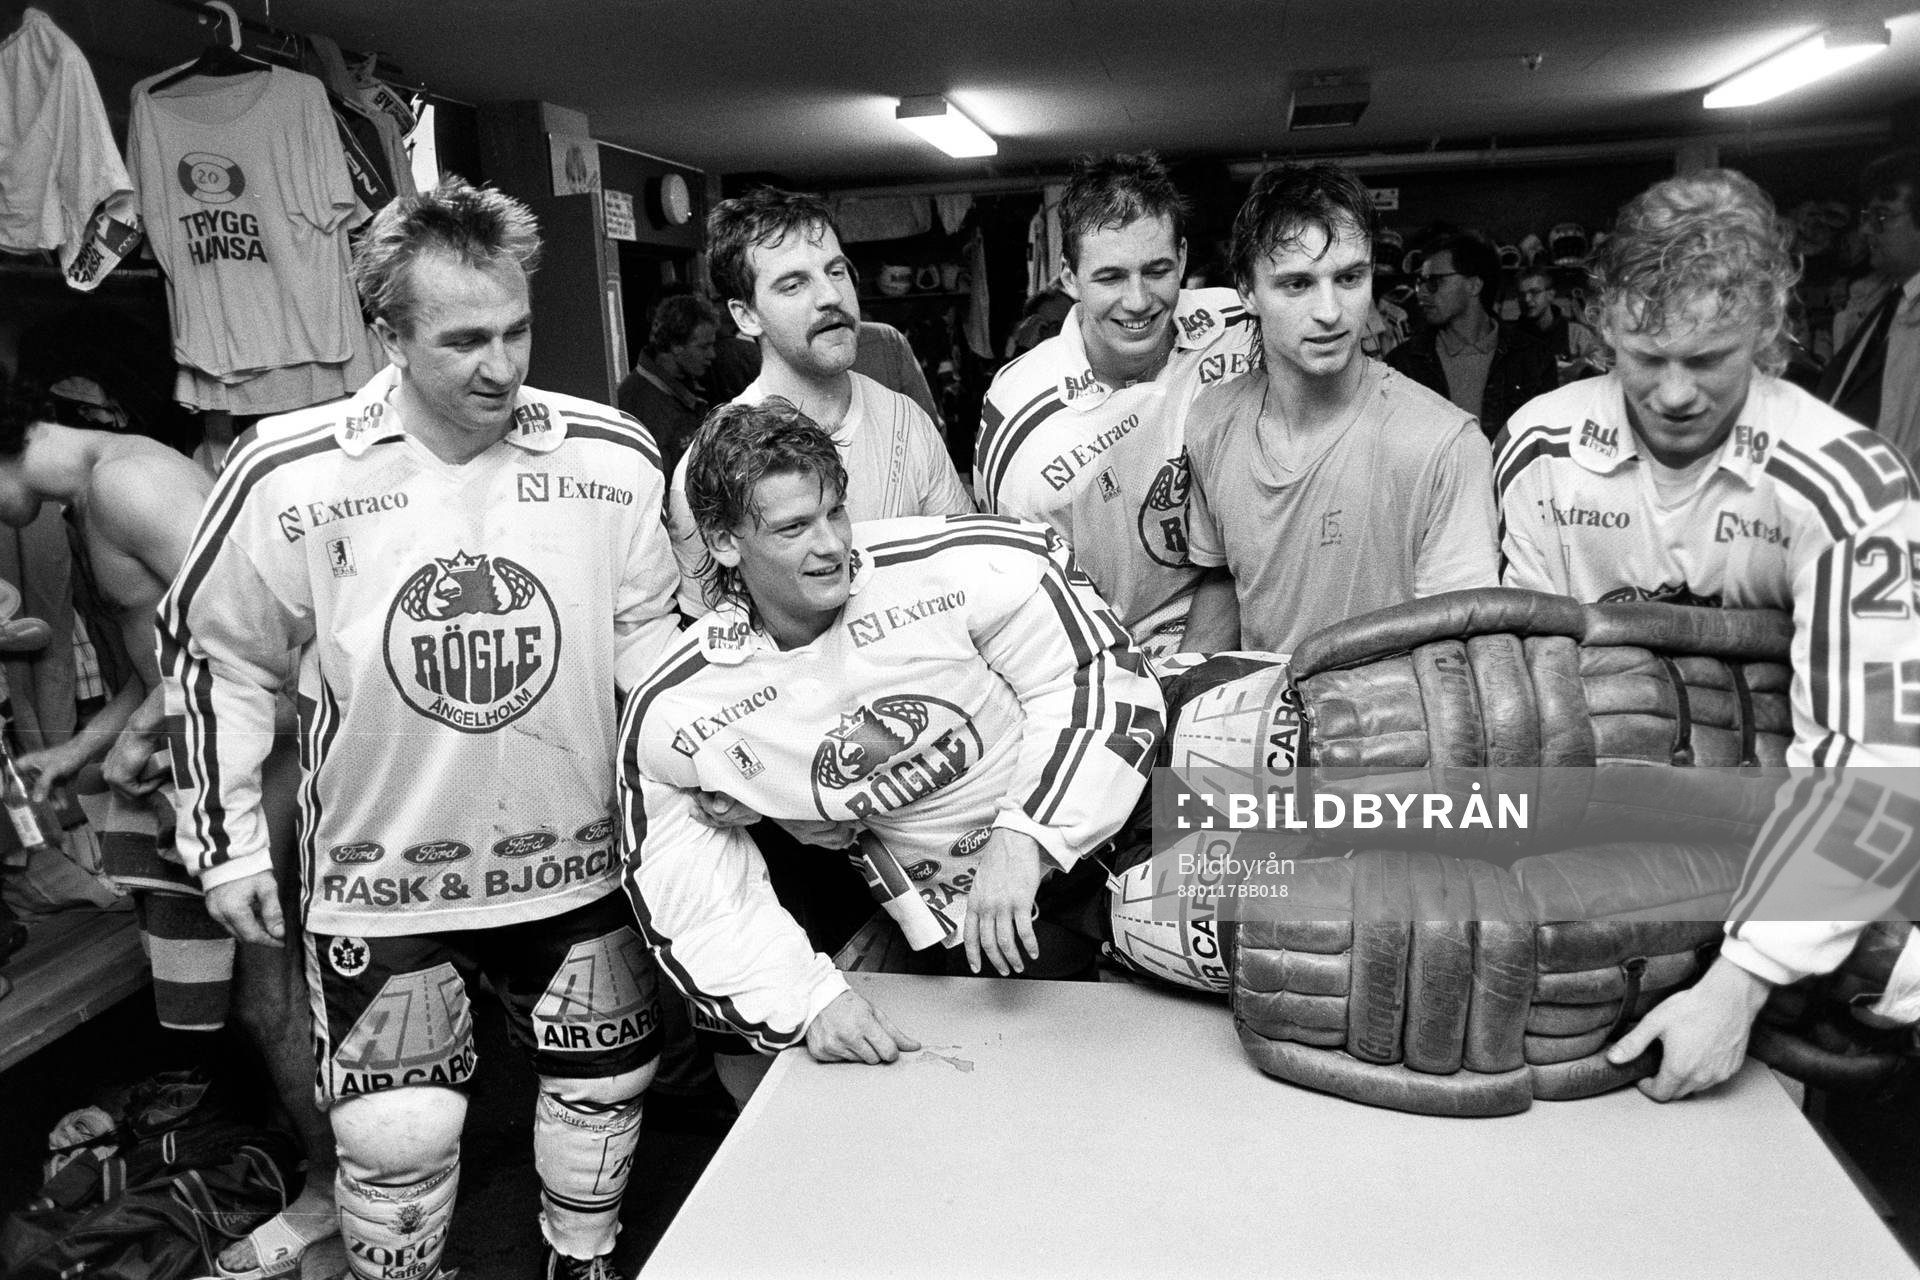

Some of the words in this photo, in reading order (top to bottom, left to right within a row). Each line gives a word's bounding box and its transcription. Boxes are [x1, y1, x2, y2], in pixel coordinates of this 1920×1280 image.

[179, 209, 259, 239] TRYGG
[187, 236, 268, 266] HANSA
[1070, 414, 1139, 468] Extraco
[556, 475, 633, 506] Extraco
[307, 491, 409, 527] Extraco
[1550, 498, 1630, 529] xtraco
[1850, 535, 1920, 620] 2
[885, 590, 966, 630] Extraco
[411, 624, 542, 705] RÖGLE
[428, 687, 533, 727] ÄNGELHOLM
[690, 686, 778, 741] Extraco
[845, 728, 969, 820] RÖGLE
[336, 843, 379, 862] Ford
[415, 842, 460, 862] Ford
[505, 834, 545, 855] Ford
[958, 828, 991, 854] Ford
[323, 874, 430, 907] RASK
[439, 872, 472, 901] &
[919, 867, 978, 910] RAS
[545, 1024, 592, 1048] AIR
[382, 1261, 427, 1279] Kaffe
